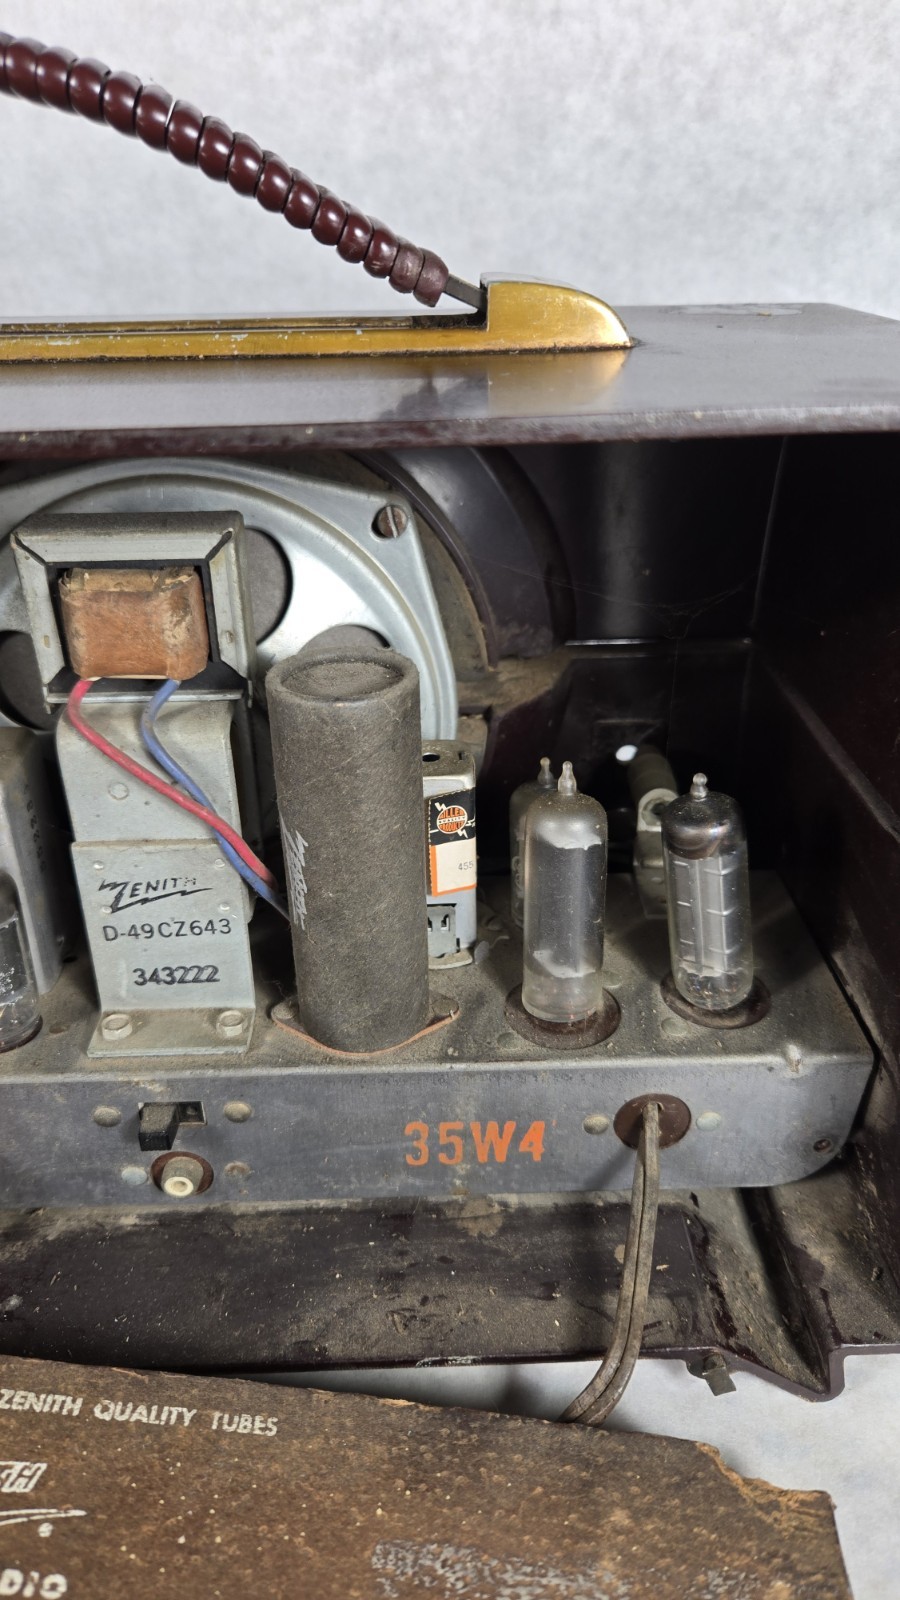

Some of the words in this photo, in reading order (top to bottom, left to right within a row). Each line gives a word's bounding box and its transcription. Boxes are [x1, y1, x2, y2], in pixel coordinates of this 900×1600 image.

[98, 876, 213, 914] ZENITH
[103, 918, 232, 942] D-49CZ643
[133, 965, 221, 986] 343222
[404, 1120, 546, 1167] 35W4
[0, 1388, 83, 1417] ZENITH
[93, 1399, 197, 1427] QUALITY
[211, 1411, 279, 1437] TUBES
